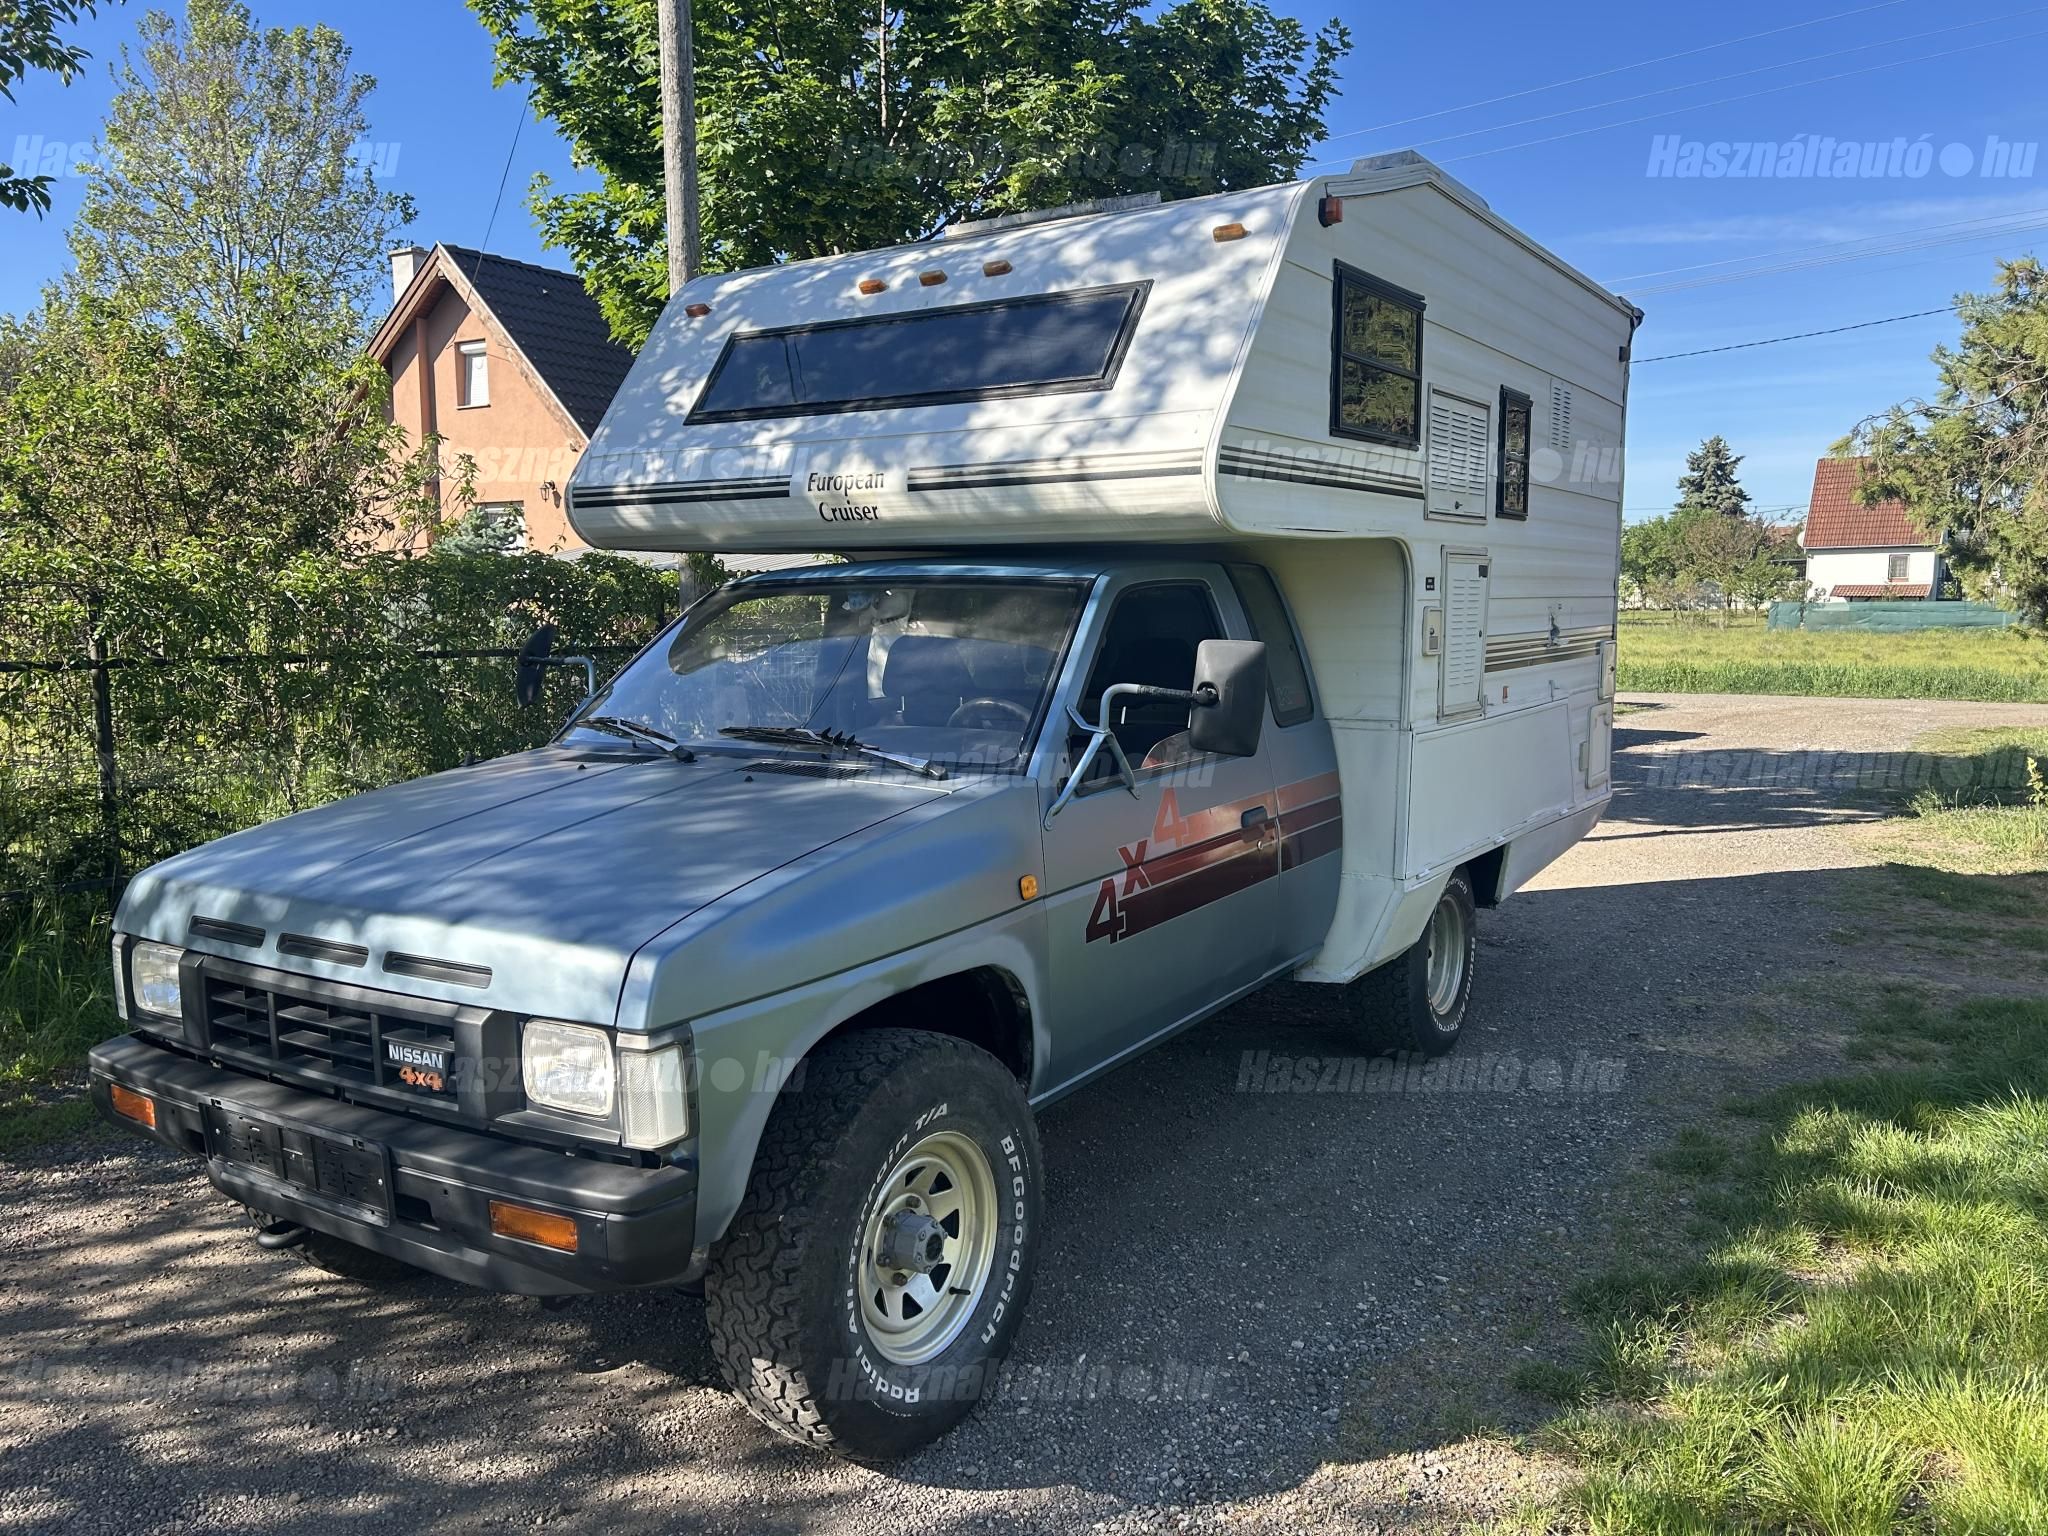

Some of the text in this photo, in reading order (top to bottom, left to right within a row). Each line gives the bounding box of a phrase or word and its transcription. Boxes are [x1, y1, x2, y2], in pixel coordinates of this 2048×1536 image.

[808, 472, 885, 497] European
[819, 499, 879, 522] Cruiser
[1464, 936, 1476, 1001] Radial
[388, 1043, 443, 1069] NISSAN
[855, 1344, 920, 1403] Radial
[914, 1102, 948, 1132] T/A
[980, 1135, 1025, 1345] BFGoodrich
